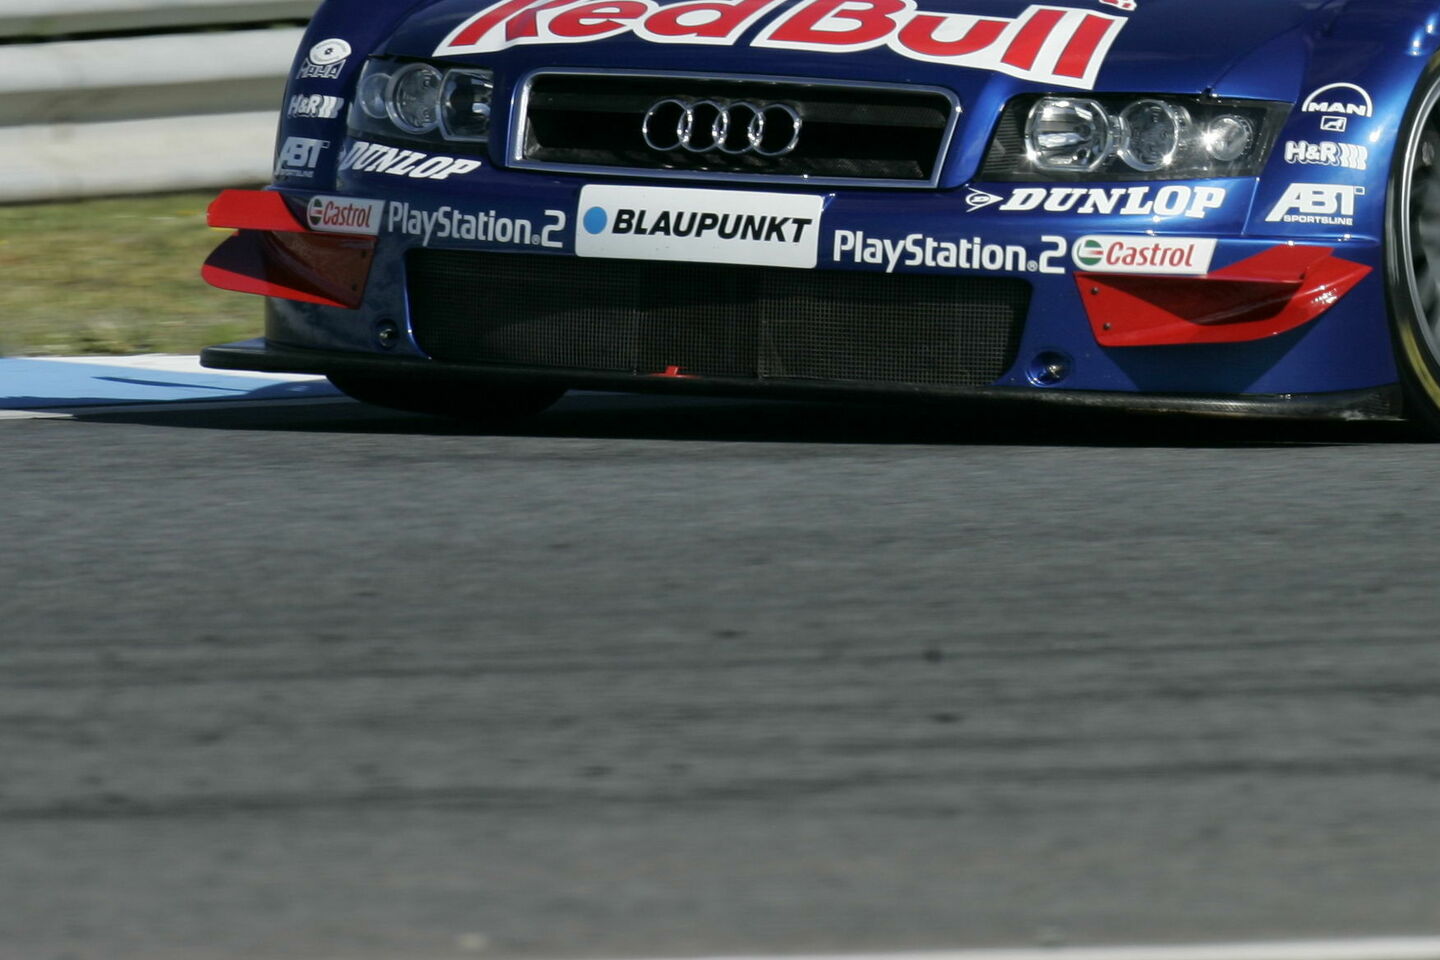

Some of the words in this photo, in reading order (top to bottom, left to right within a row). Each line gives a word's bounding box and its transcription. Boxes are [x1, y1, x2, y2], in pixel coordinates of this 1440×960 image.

[288, 93, 325, 121] H&R
[1307, 101, 1366, 116] MAN
[274, 137, 322, 175] ABT
[340, 141, 481, 180] DUNLOP
[1284, 140, 1339, 167] H&R
[323, 200, 373, 229] Castrol
[999, 185, 1227, 219] DUNLOP
[1265, 182, 1355, 222] ABT
[611, 208, 813, 244] BLAUPUNKT
[1283, 214, 1354, 226] SPORTSLINE
[1105, 241, 1196, 268] Castrol
